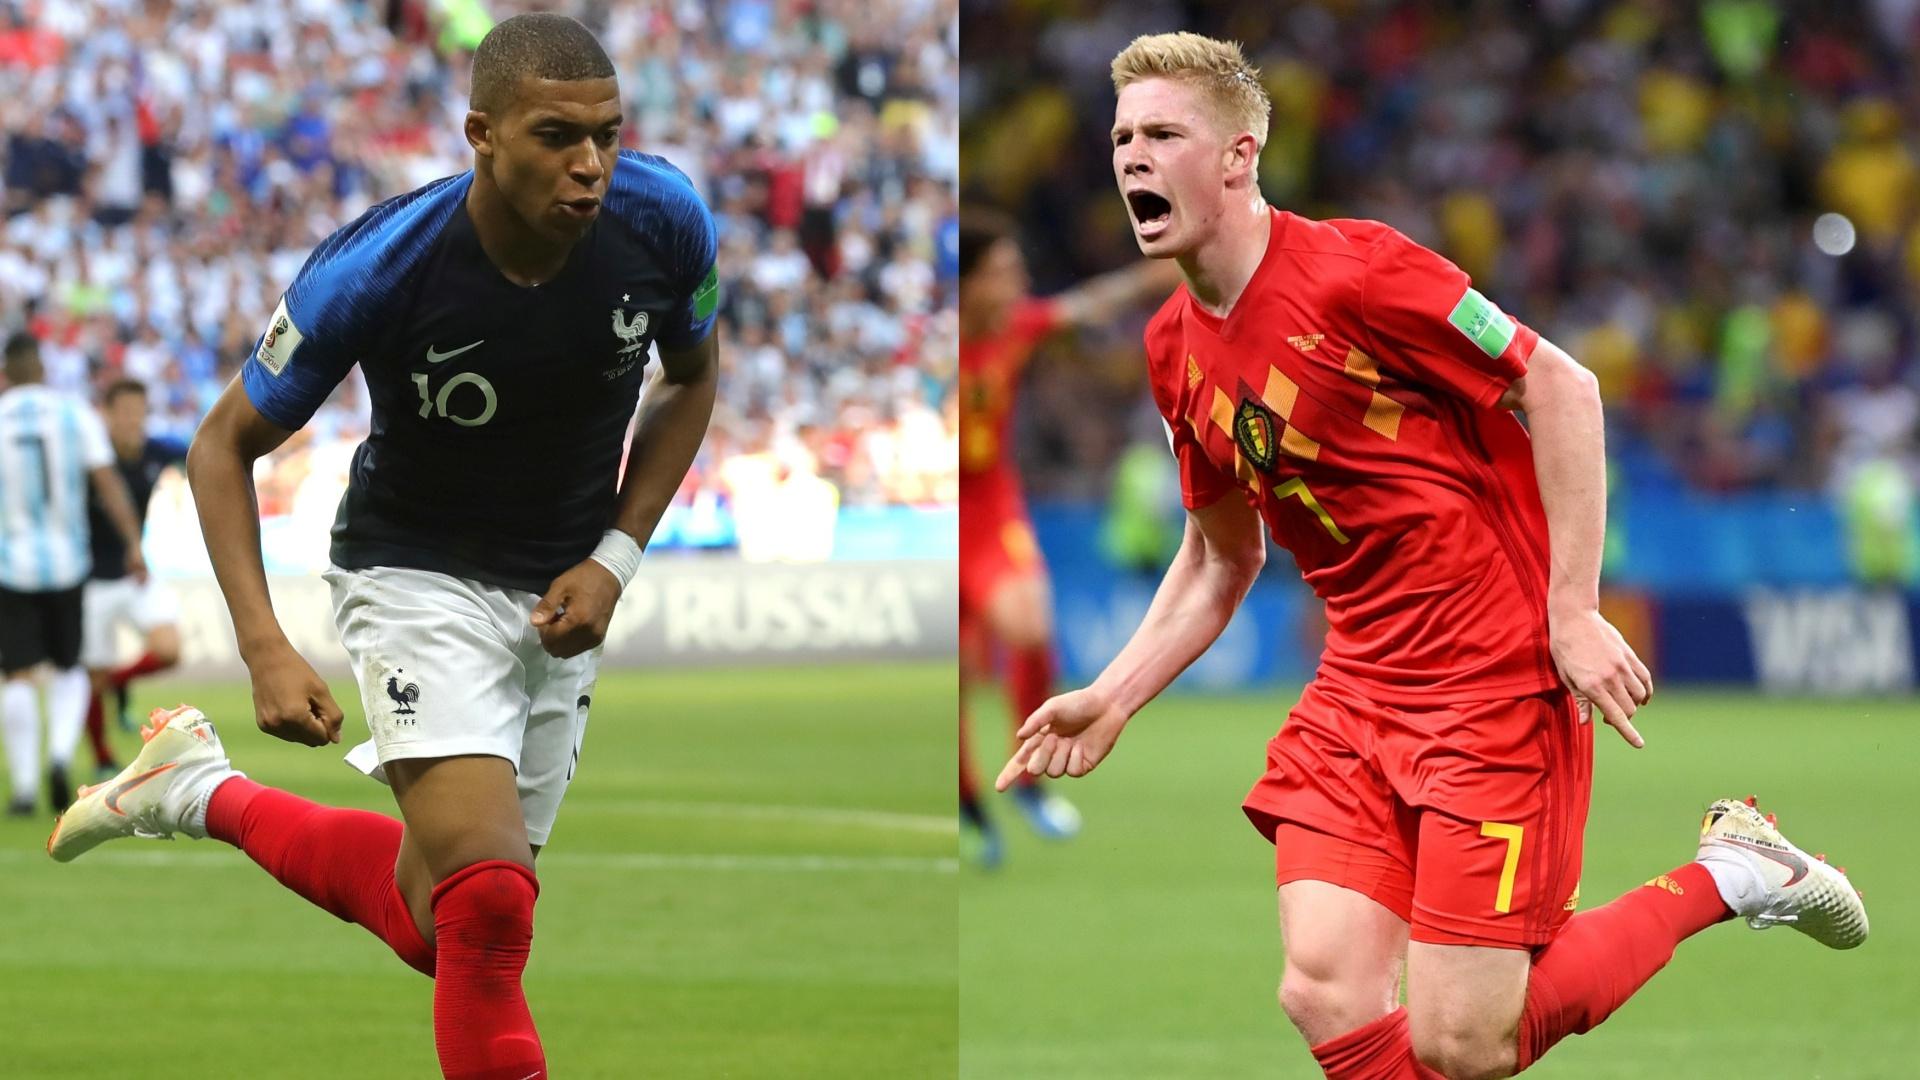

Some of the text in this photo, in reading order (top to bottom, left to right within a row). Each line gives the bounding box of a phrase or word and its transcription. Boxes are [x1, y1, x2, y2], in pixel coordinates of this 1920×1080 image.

[411, 372, 498, 427] 10
[1272, 475, 1351, 545] 7
[665, 574, 922, 650] RUSSIA
[395, 718, 416, 726] FFF
[1480, 821, 1524, 914] 7
